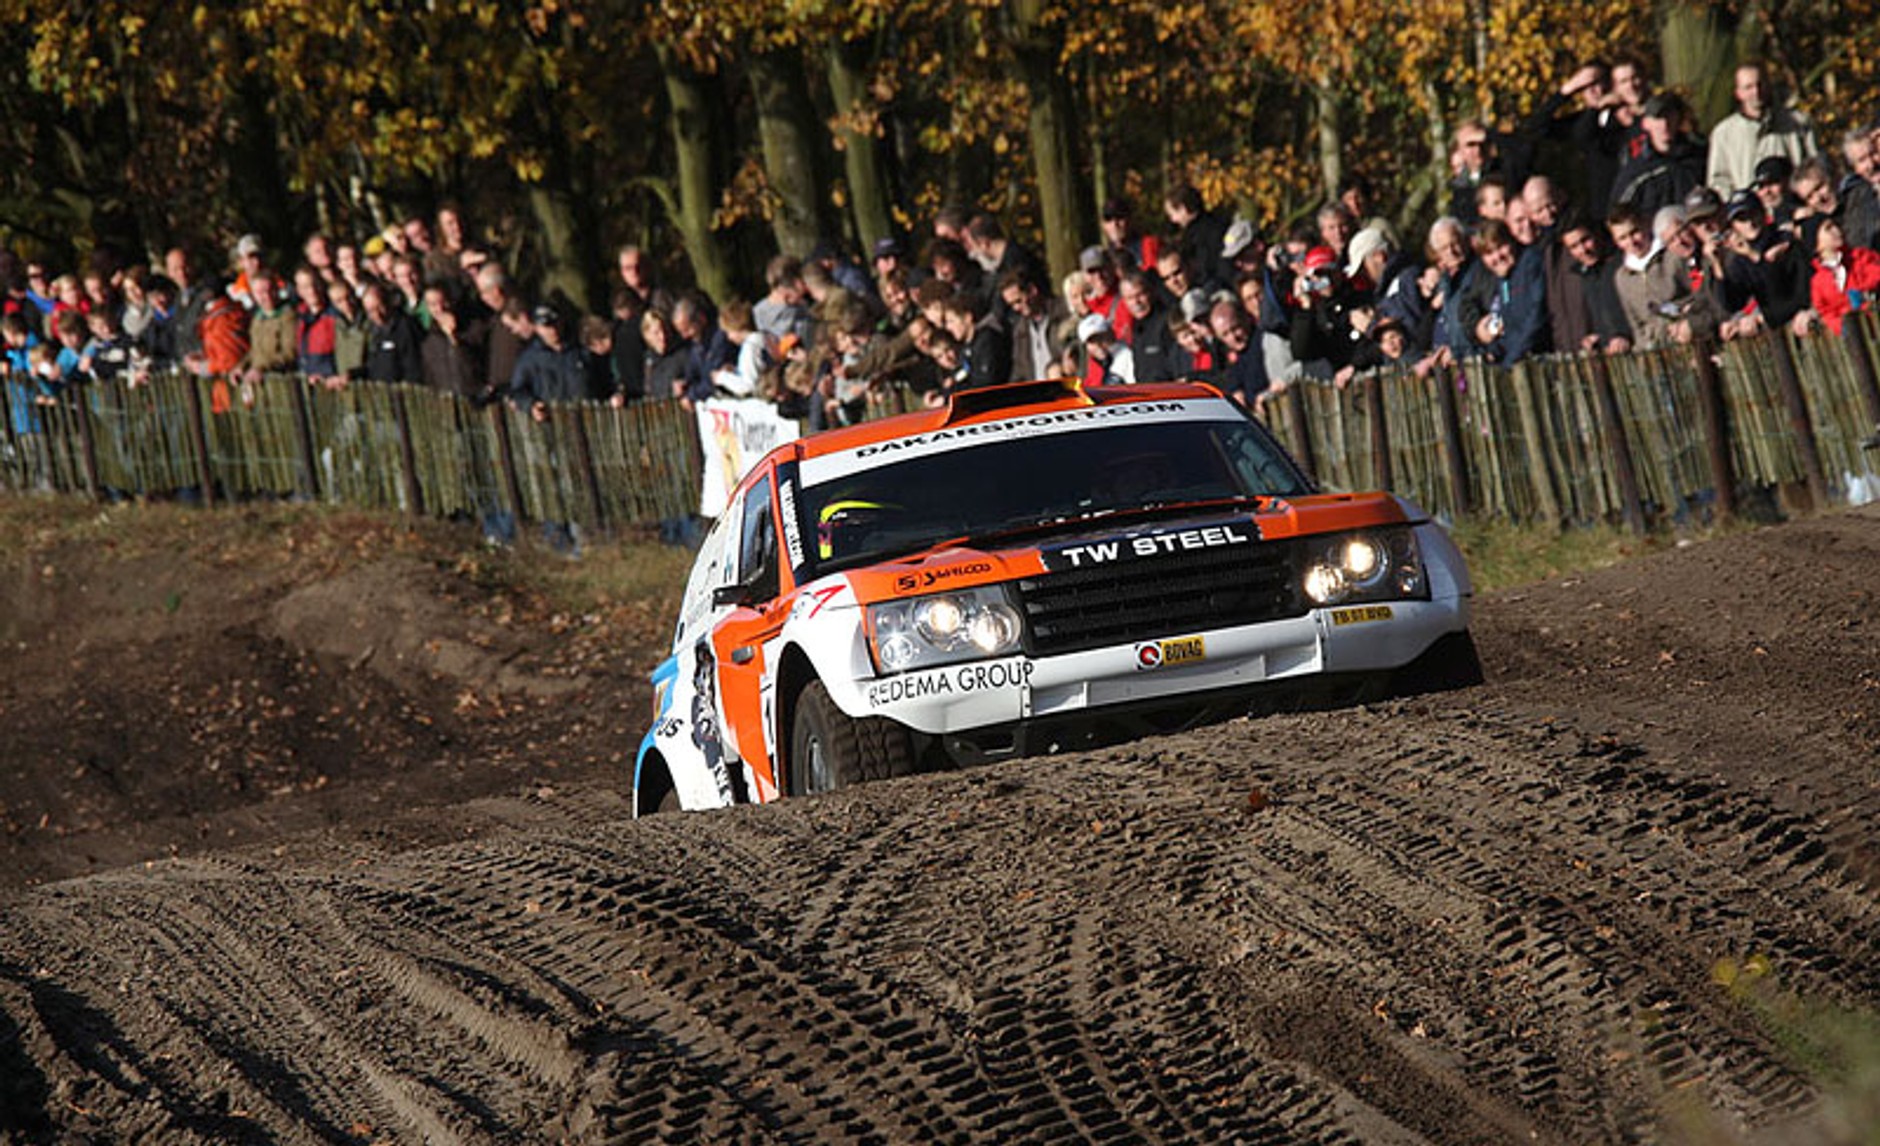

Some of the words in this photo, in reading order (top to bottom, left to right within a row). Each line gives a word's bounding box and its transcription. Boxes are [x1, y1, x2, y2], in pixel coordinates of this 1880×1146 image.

[856, 401, 1185, 458] DAKARSPORT.COM
[1062, 542, 1118, 566] TW
[1132, 526, 1248, 556] STEEL
[869, 672, 953, 707] REDEMA
[957, 661, 1035, 691] GROUP
